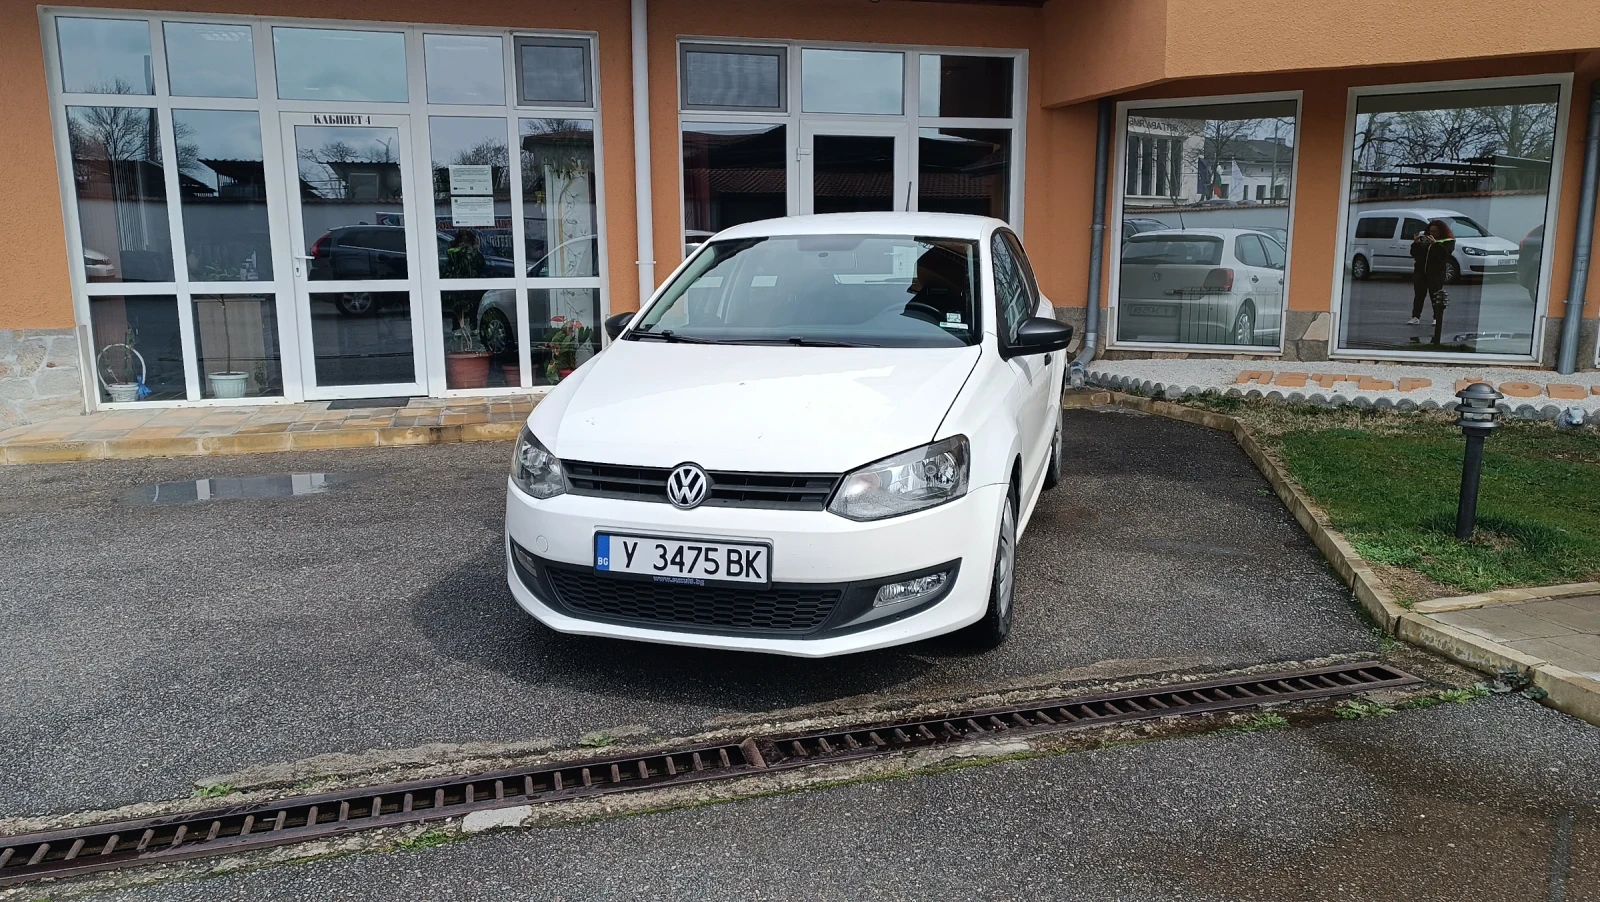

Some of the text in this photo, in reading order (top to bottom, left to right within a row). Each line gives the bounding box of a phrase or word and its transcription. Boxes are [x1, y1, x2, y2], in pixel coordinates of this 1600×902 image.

[313, 114, 371, 125] КАБИНЕТ 4
[668, 465, 707, 508] VW
[597, 556, 609, 566] BG
[653, 543, 720, 575] 3475
